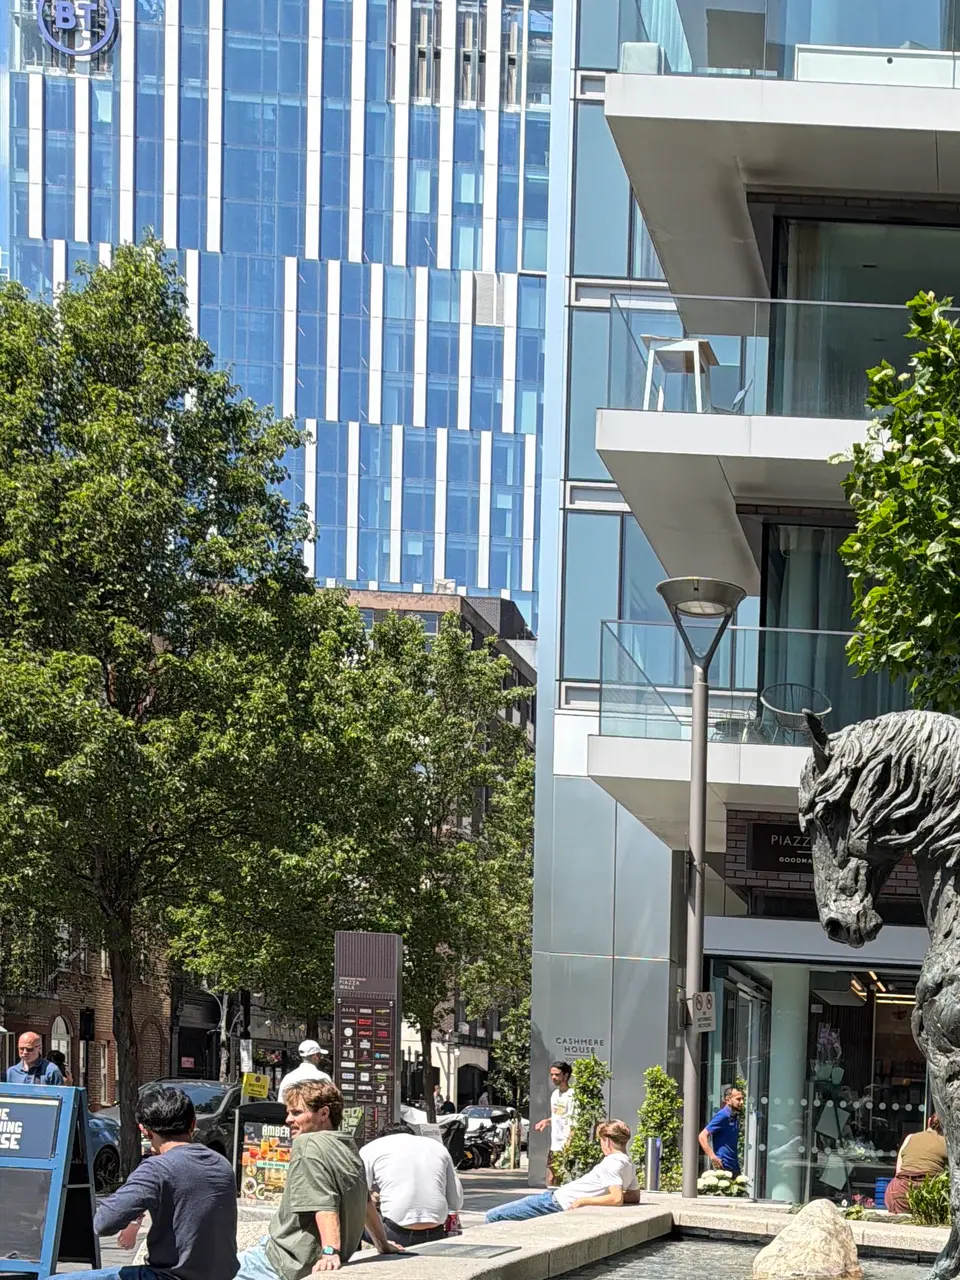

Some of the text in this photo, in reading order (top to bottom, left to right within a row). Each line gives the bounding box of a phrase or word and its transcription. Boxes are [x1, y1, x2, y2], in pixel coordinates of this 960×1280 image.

[55, 0, 98, 31] BT
[771, 834, 811, 847] PIAZZ
[779, 856, 813, 864] GOODMA
[555, 1037, 605, 1046] CASHMERE
[564, 1046, 596, 1054] HOUSE
